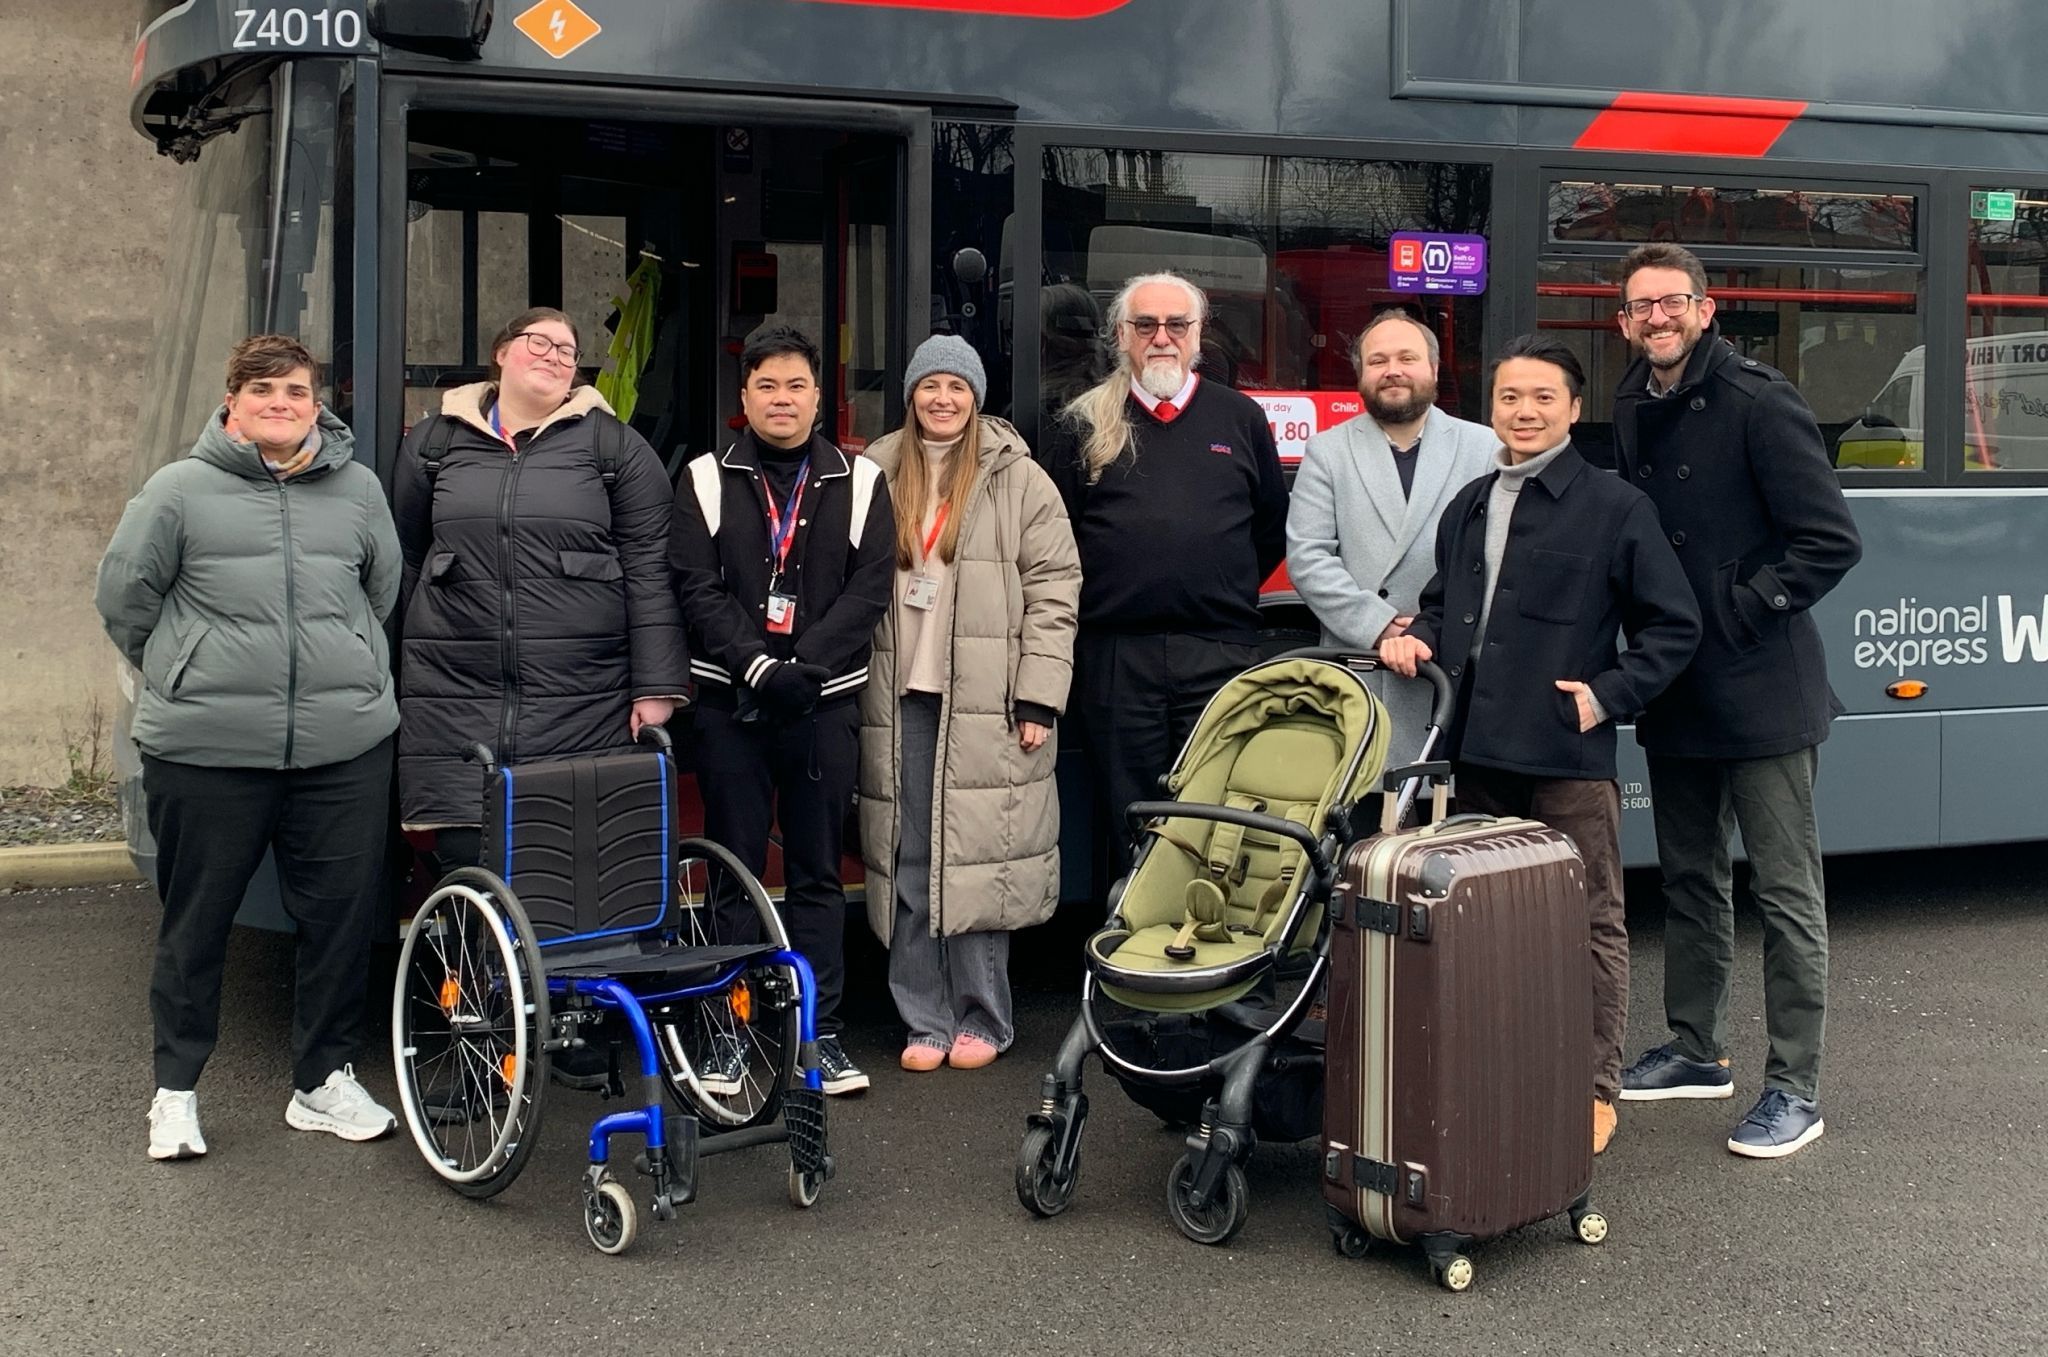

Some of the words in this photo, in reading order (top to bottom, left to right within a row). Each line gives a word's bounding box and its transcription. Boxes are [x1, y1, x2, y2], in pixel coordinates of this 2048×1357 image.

[232, 8, 361, 48] Z4010
[1273, 403, 1292, 414] day
[1331, 402, 1359, 413] Child
[1854, 595, 1988, 636] national
[1854, 637, 1988, 677] express
[1624, 783, 1642, 794] LTD
